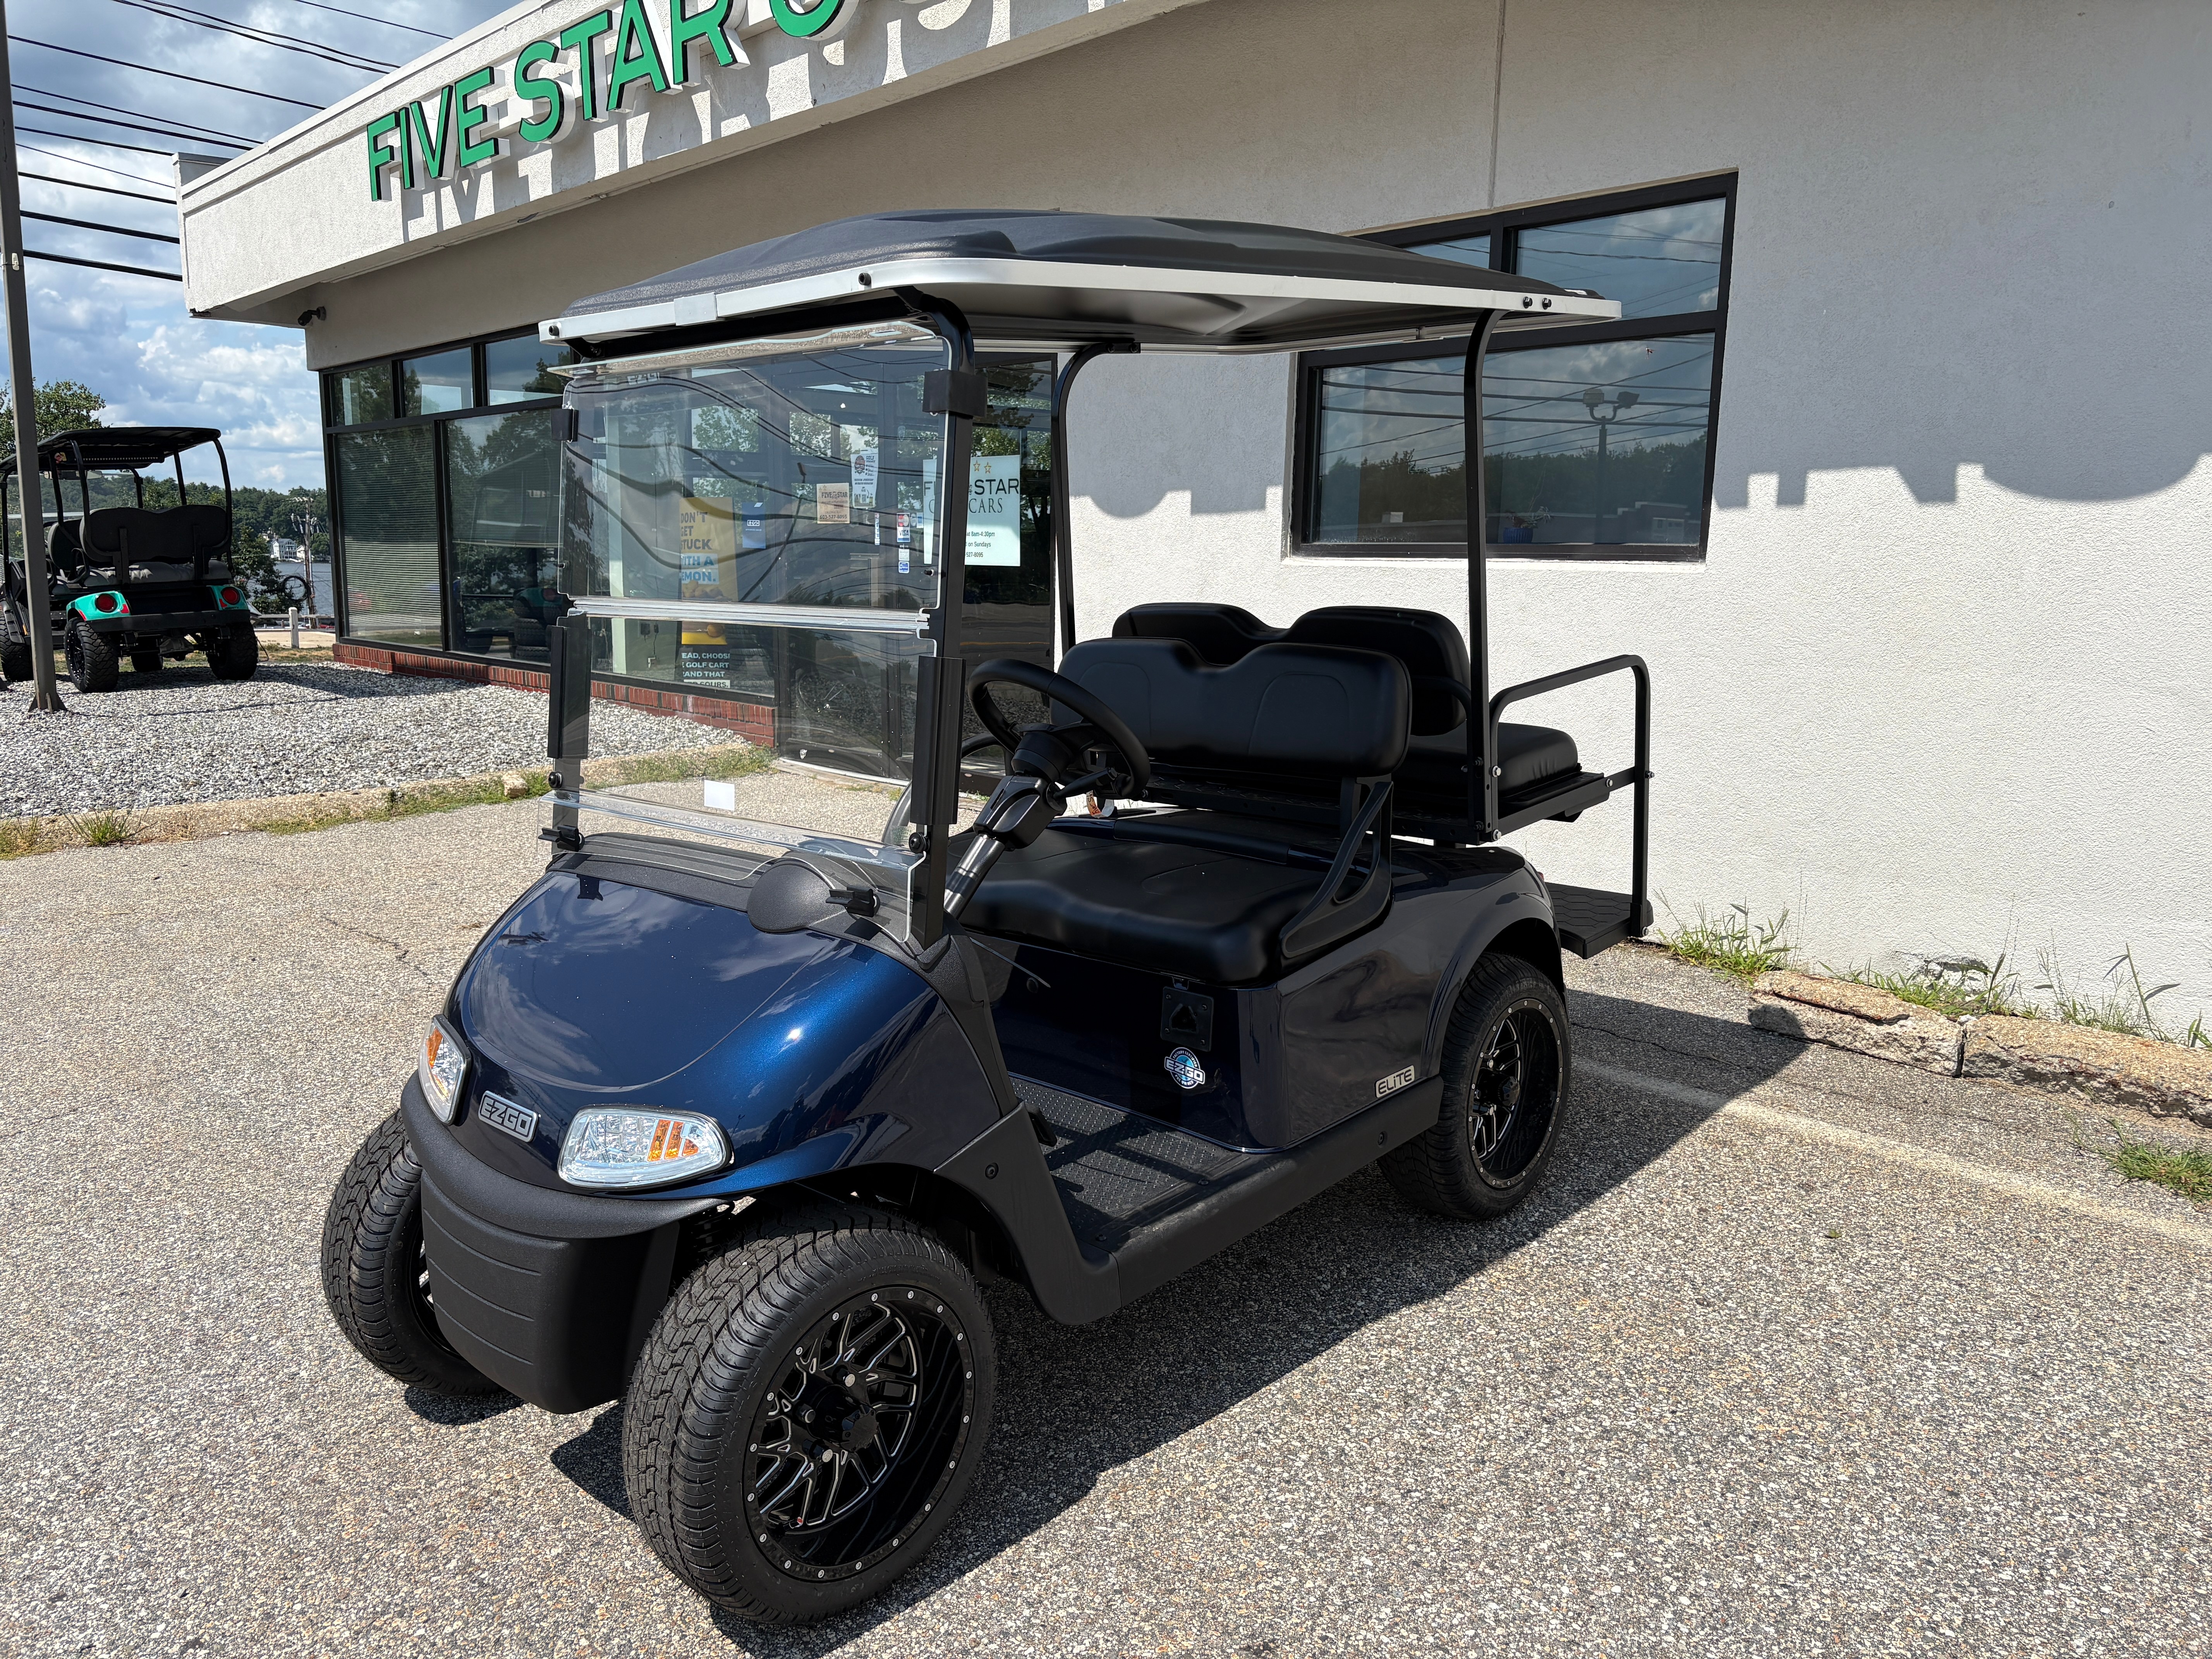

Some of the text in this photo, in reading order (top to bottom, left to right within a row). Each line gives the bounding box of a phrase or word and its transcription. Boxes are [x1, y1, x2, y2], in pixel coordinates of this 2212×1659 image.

[366, 0, 739, 201] FIVE STAR
[974, 479, 1019, 495] STAR
[969, 498, 1003, 513] CARS
[704, 556, 714, 566] A
[682, 571, 716, 581] EMON.
[1166, 1059, 1203, 1082] EZGO
[481, 1097, 532, 1135] EZGO
